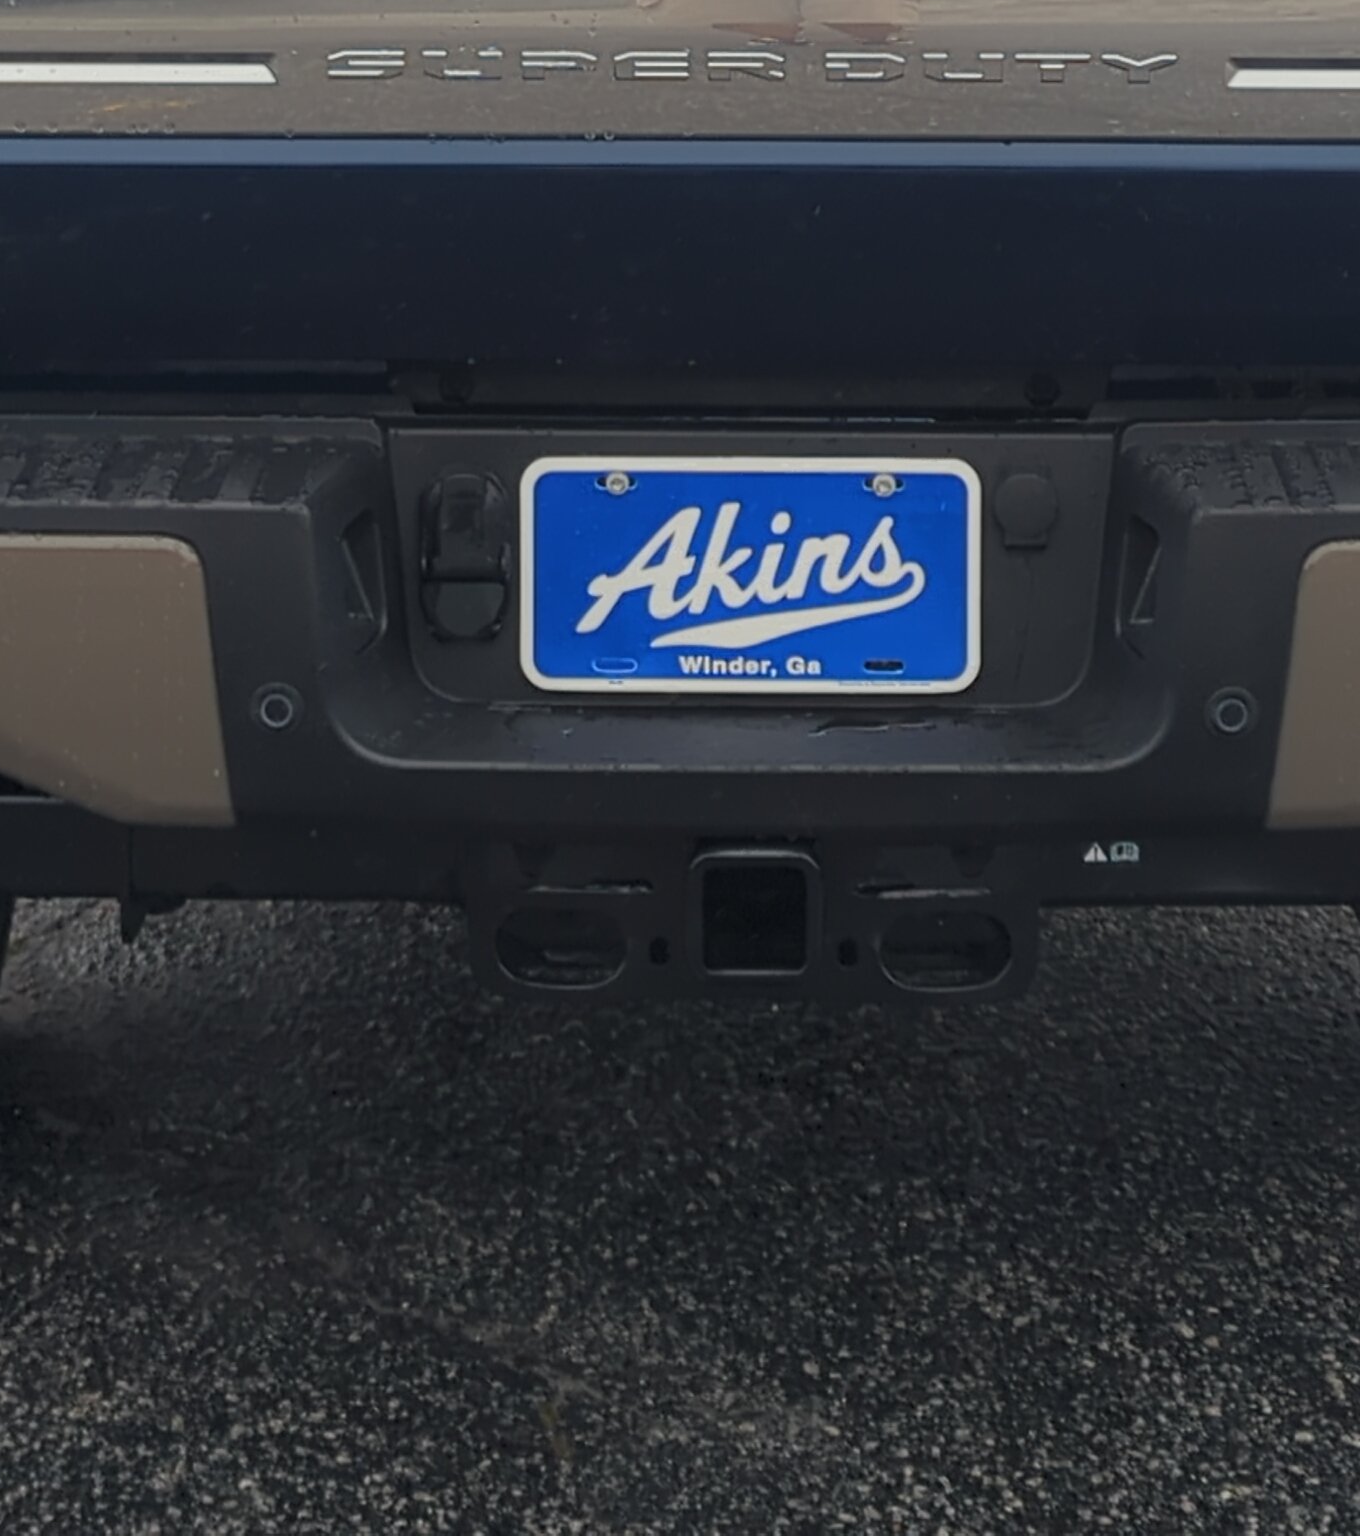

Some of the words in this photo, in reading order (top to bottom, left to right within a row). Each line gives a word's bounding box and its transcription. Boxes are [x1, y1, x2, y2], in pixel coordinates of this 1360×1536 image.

[327, 49, 786, 82] SUPER
[824, 52, 1179, 84] DUTY
[575, 501, 926, 642] Akins
[678, 655, 778, 678] Winder,
[785, 655, 822, 675] Ga
